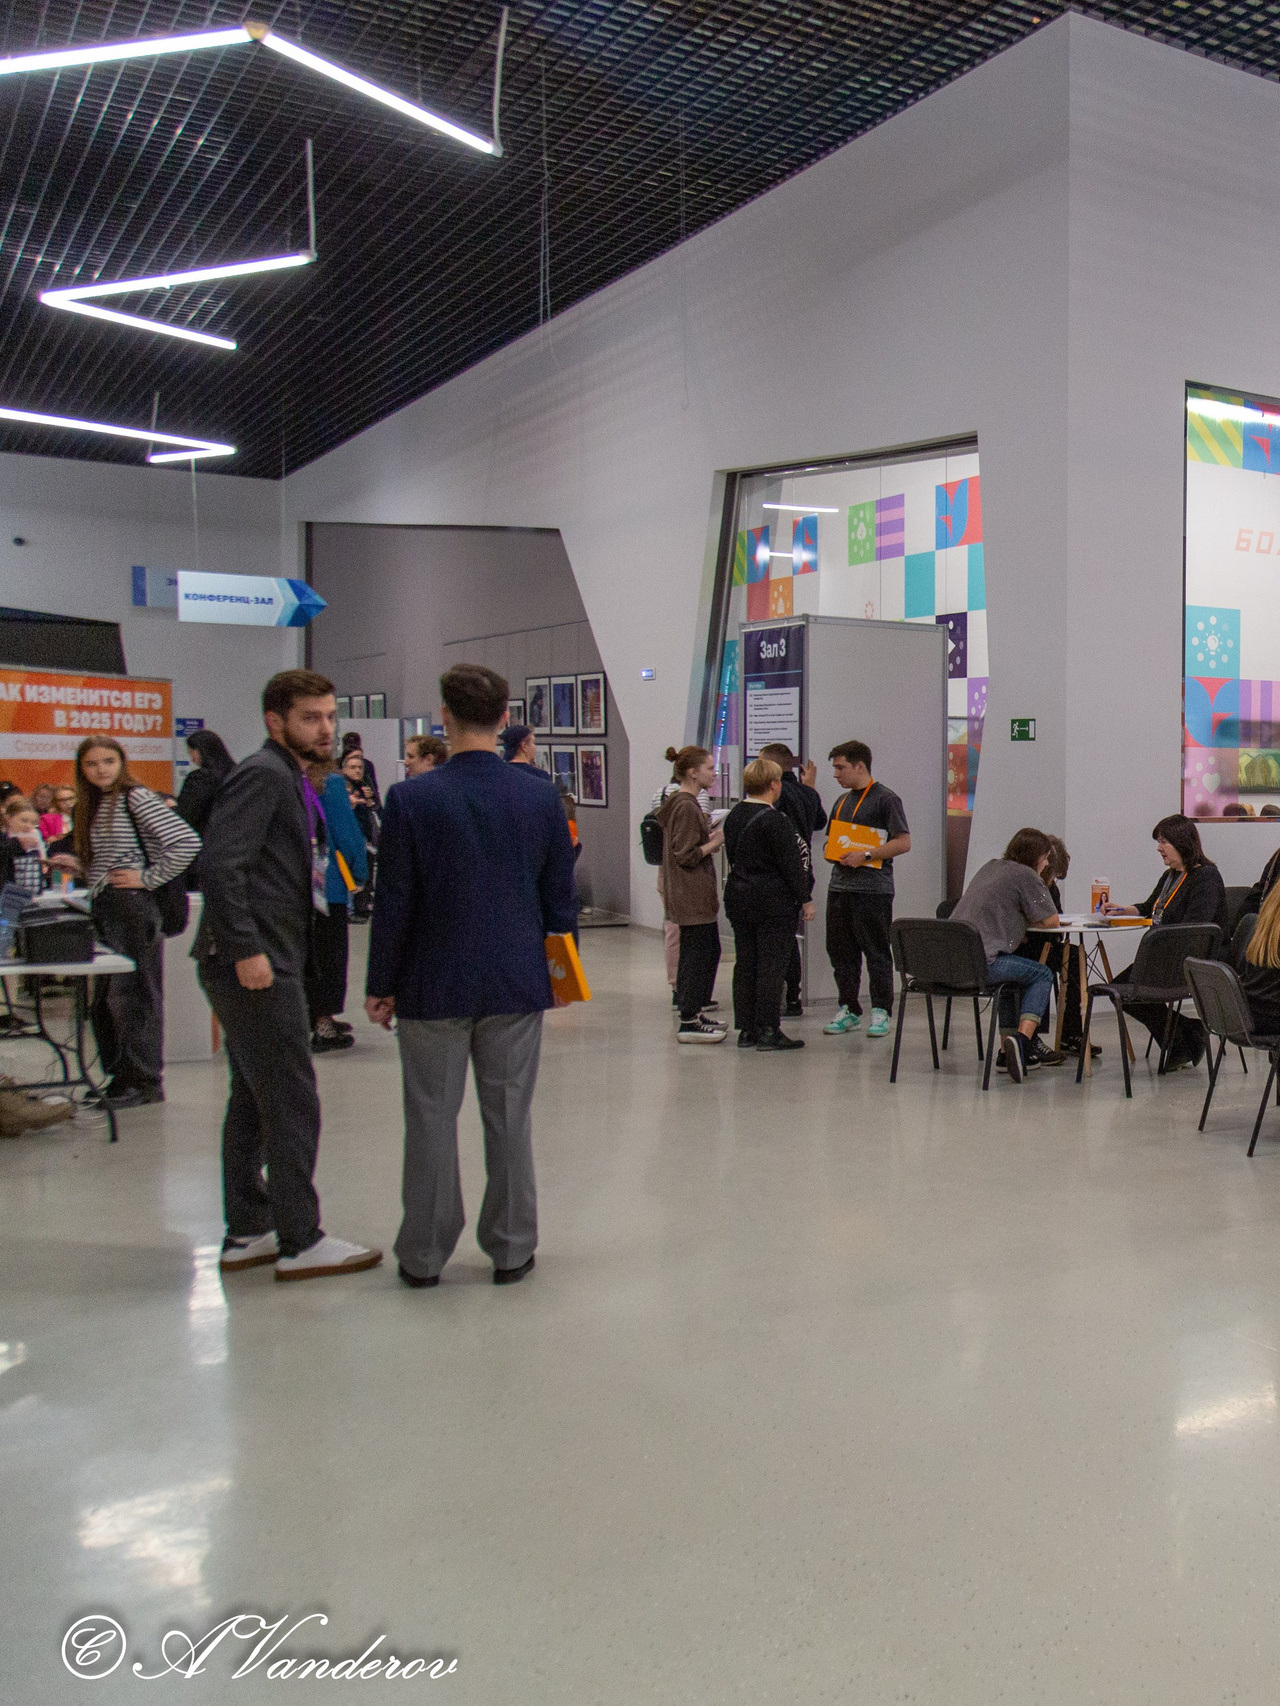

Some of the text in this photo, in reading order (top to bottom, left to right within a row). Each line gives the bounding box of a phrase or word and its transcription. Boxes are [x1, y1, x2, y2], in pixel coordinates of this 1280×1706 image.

[183, 592, 275, 606] КОНФЕРЕНЦ-ЗАЛ
[759, 638, 787, 659] Зал 3
[24, 684, 132, 709] ИЗМЕНИТСЯ
[134, 692, 163, 710] ЕГЭ
[54, 710, 163, 733] В 2025 ГОДУ?
